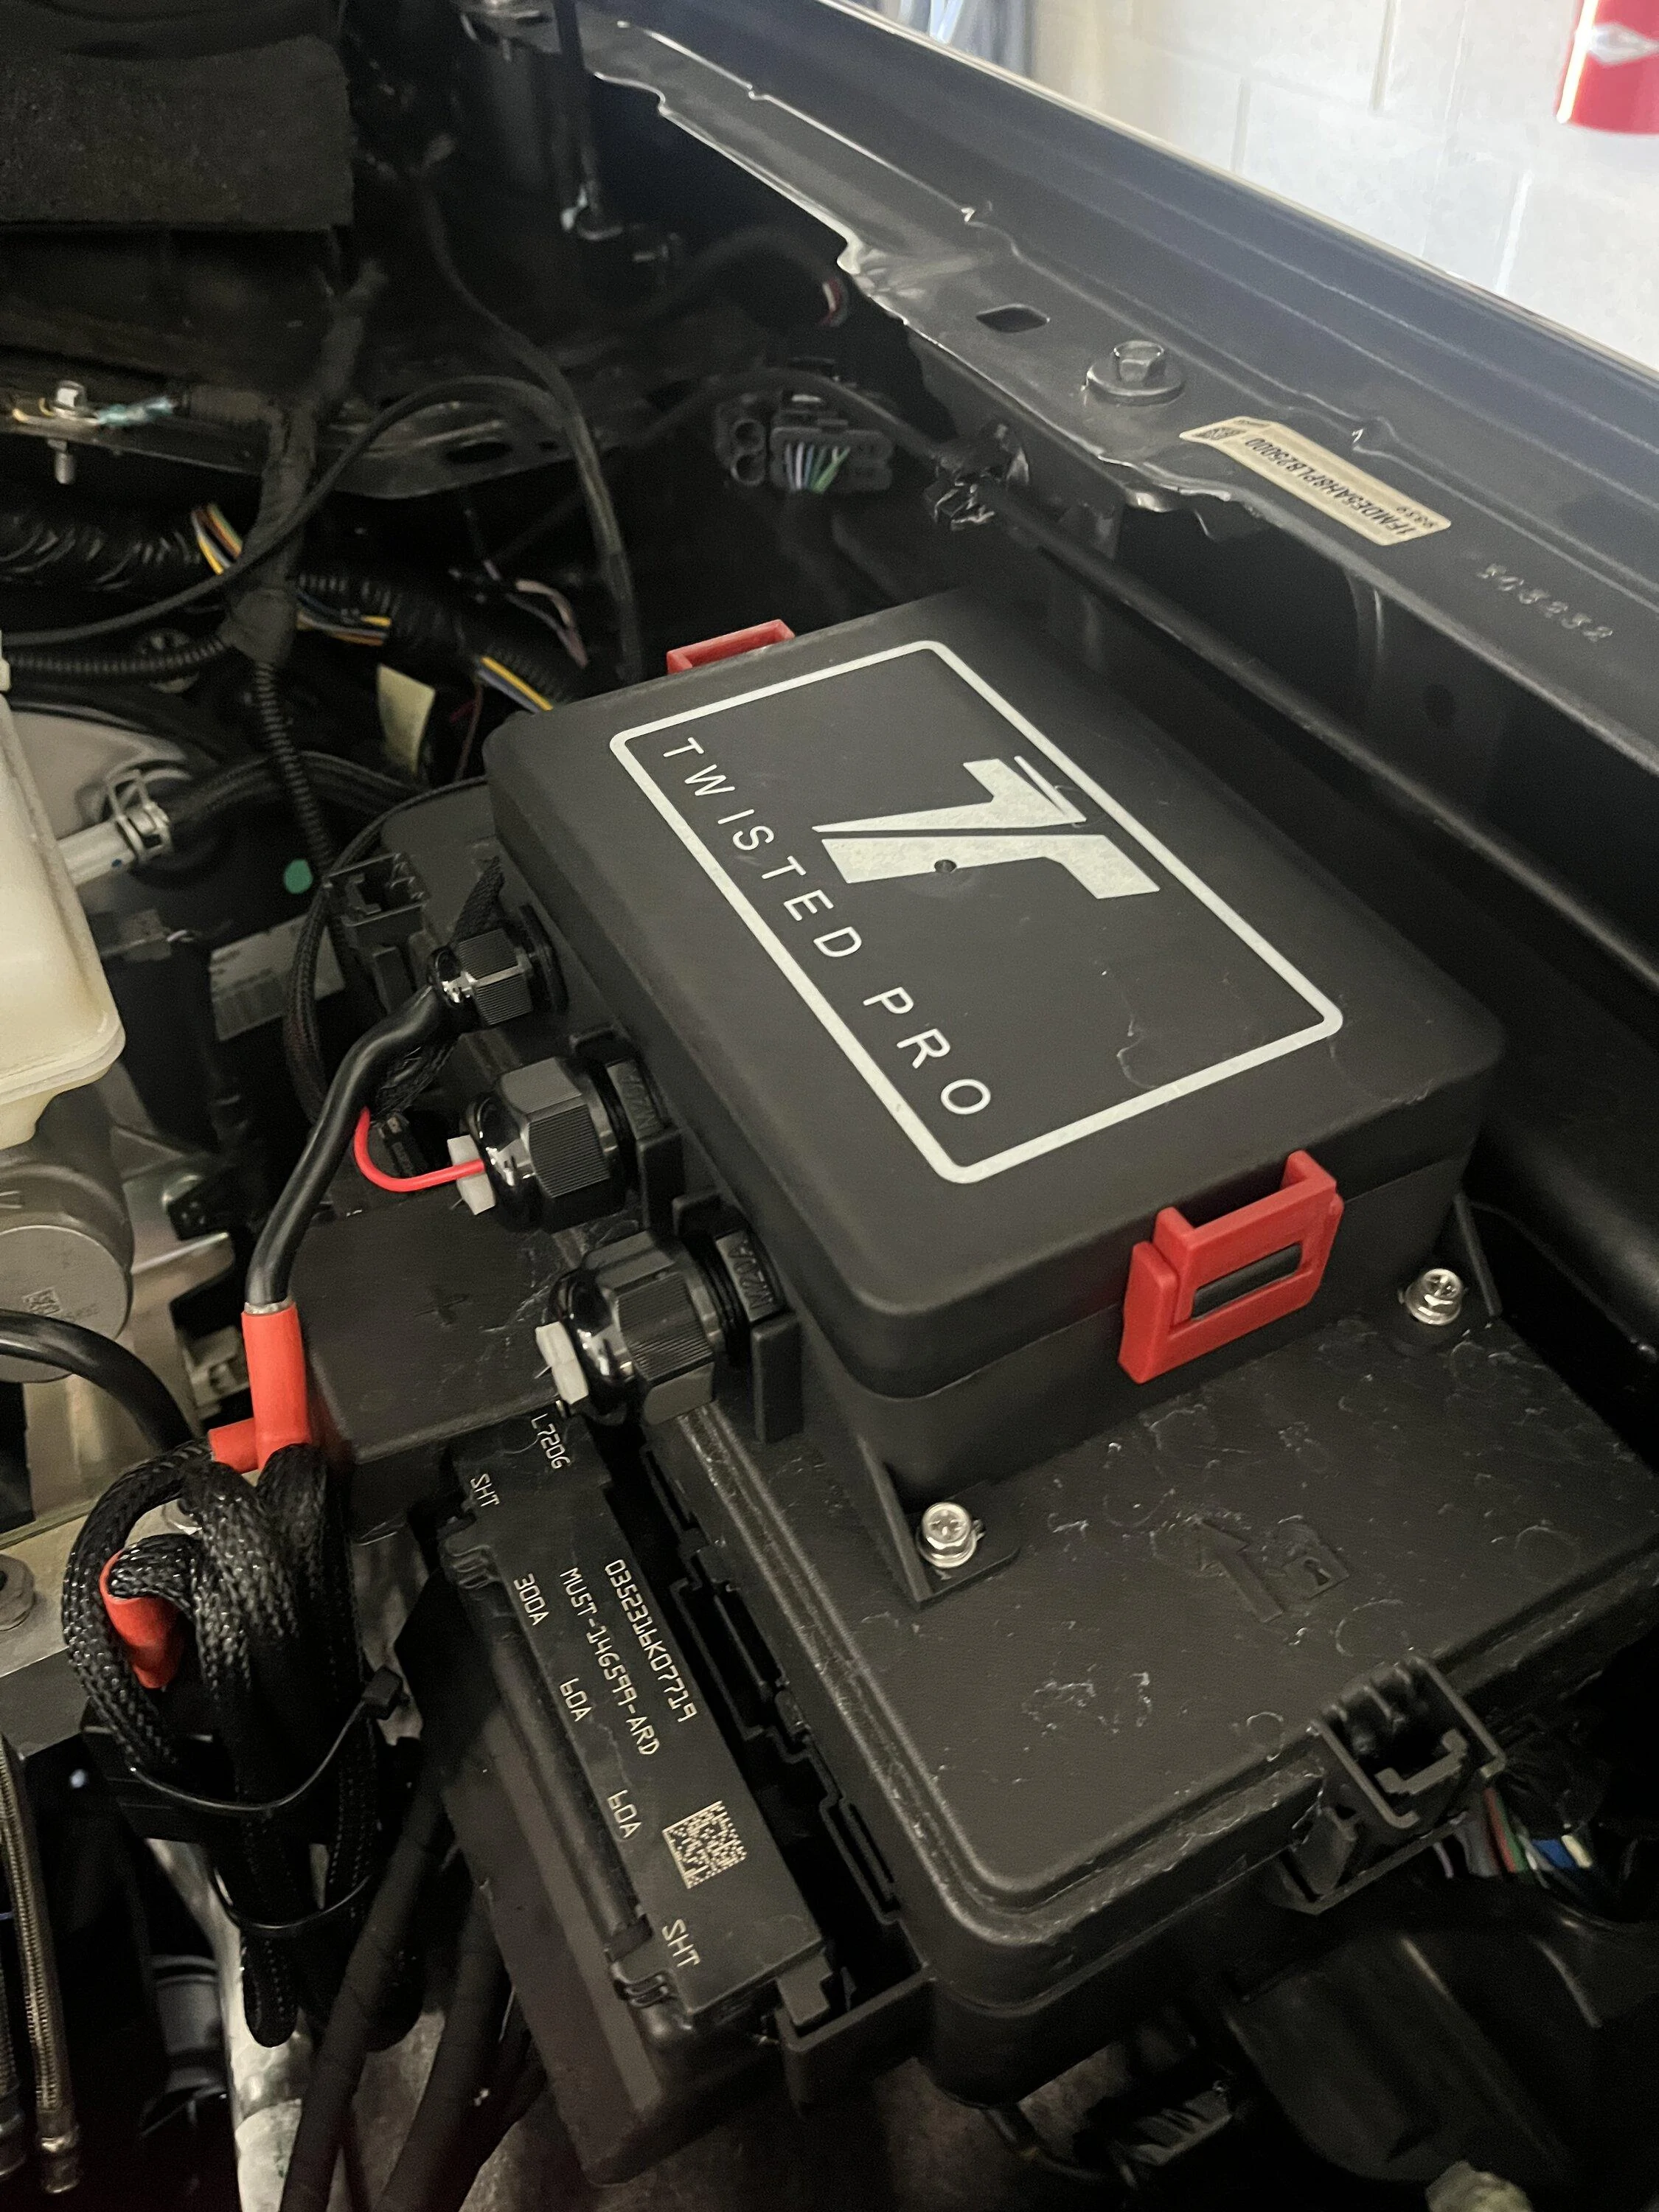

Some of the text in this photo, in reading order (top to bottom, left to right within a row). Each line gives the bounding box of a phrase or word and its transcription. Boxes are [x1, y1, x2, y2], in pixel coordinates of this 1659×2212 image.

[663, 737, 992, 1116] TWISTED PRO
[470, 1472, 501, 1508] SHT
[513, 1573, 549, 1627] 300A
[604, 1559, 698, 1723] 0352316K07719
[559, 1677, 593, 1722] 60A
[607, 1789, 641, 1839] 60A
[661, 1919, 700, 1967] SHT
